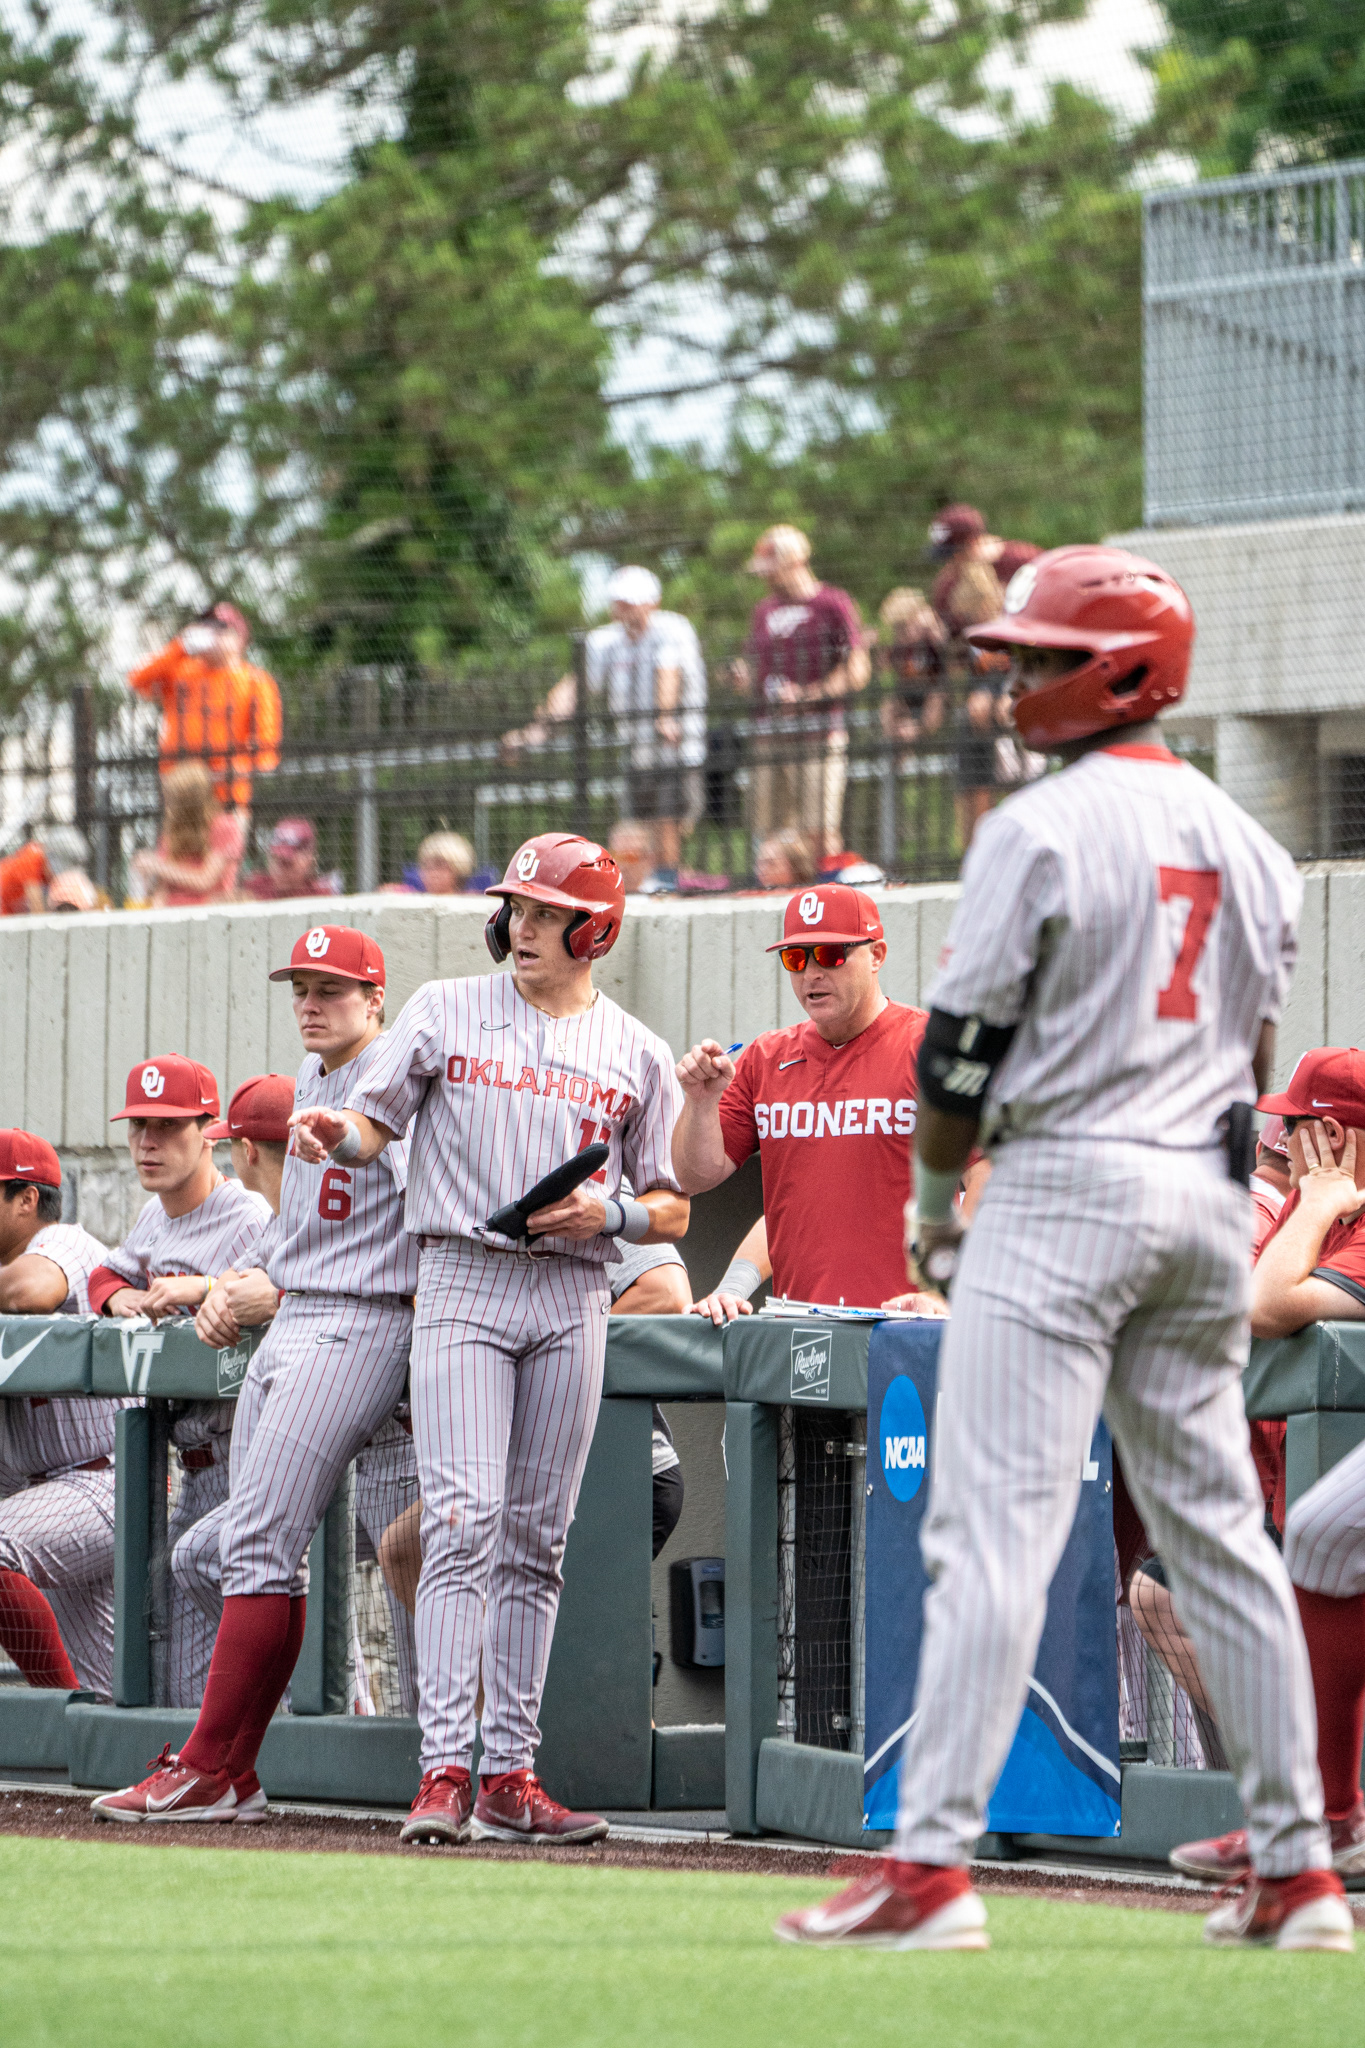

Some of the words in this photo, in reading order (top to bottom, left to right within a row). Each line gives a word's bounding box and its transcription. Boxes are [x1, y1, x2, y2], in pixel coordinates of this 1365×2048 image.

[516, 849, 540, 882] OU
[798, 892, 825, 925] OU
[305, 927, 331, 958] OU
[1156, 866, 1219, 1023] 7
[140, 1065, 166, 1098] OU
[447, 1055, 632, 1123] OKLAHOMA
[754, 1098, 918, 1140] SOONERS
[318, 1167, 352, 1221] 6
[795, 1346, 828, 1376] Rawlings
[884, 1436, 926, 1469] NCAA
